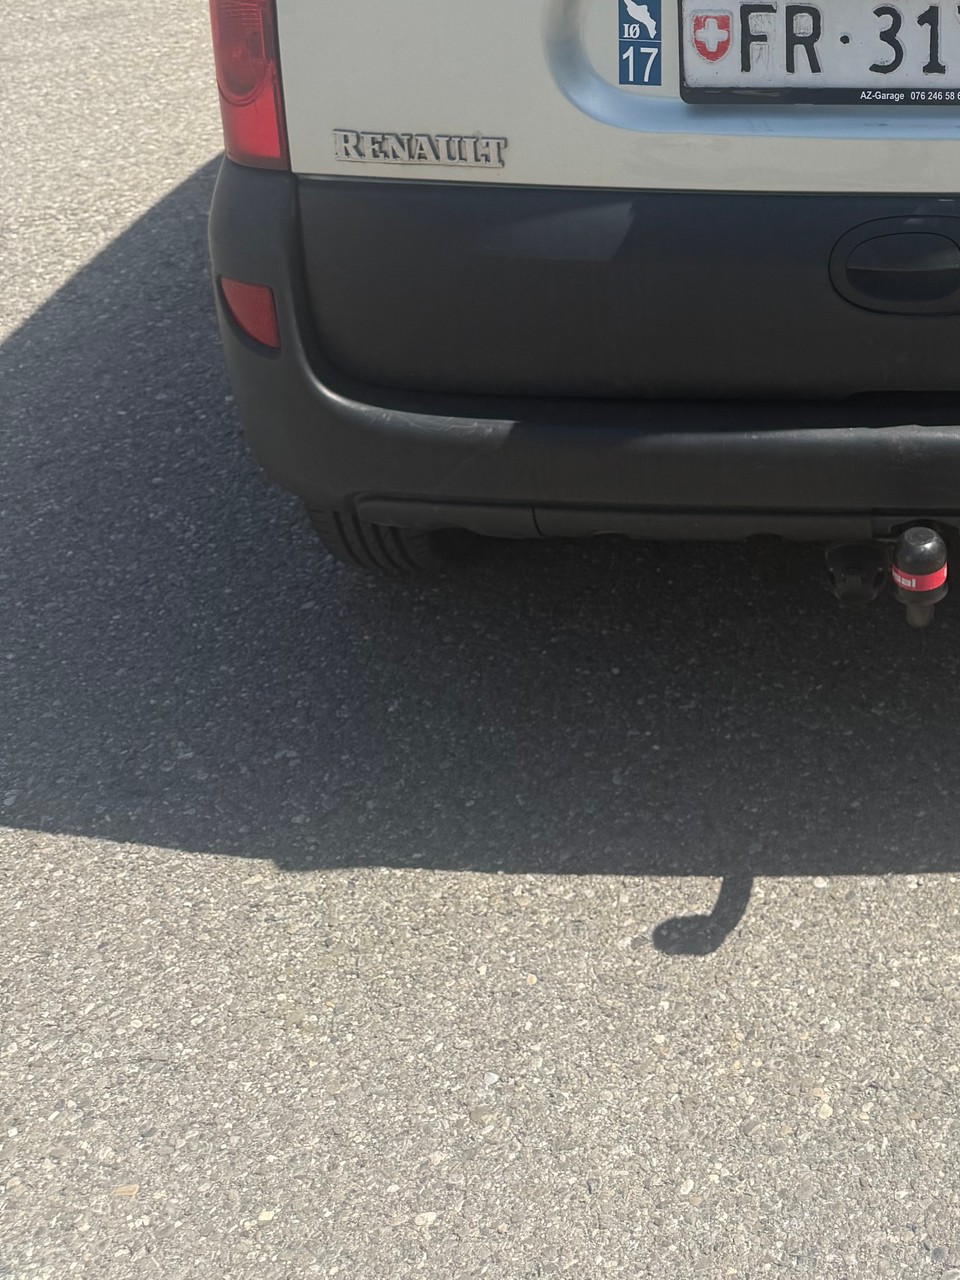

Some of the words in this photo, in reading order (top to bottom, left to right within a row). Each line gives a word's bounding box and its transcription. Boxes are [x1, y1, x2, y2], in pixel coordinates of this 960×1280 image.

[622, 45, 659, 83] 17
[860, 90, 905, 102] AZ-Garage
[910, 91, 926, 100] 076
[928, 91, 943, 100] 246
[945, 91, 955, 100] 58
[333, 128, 508, 168] RENAULT
